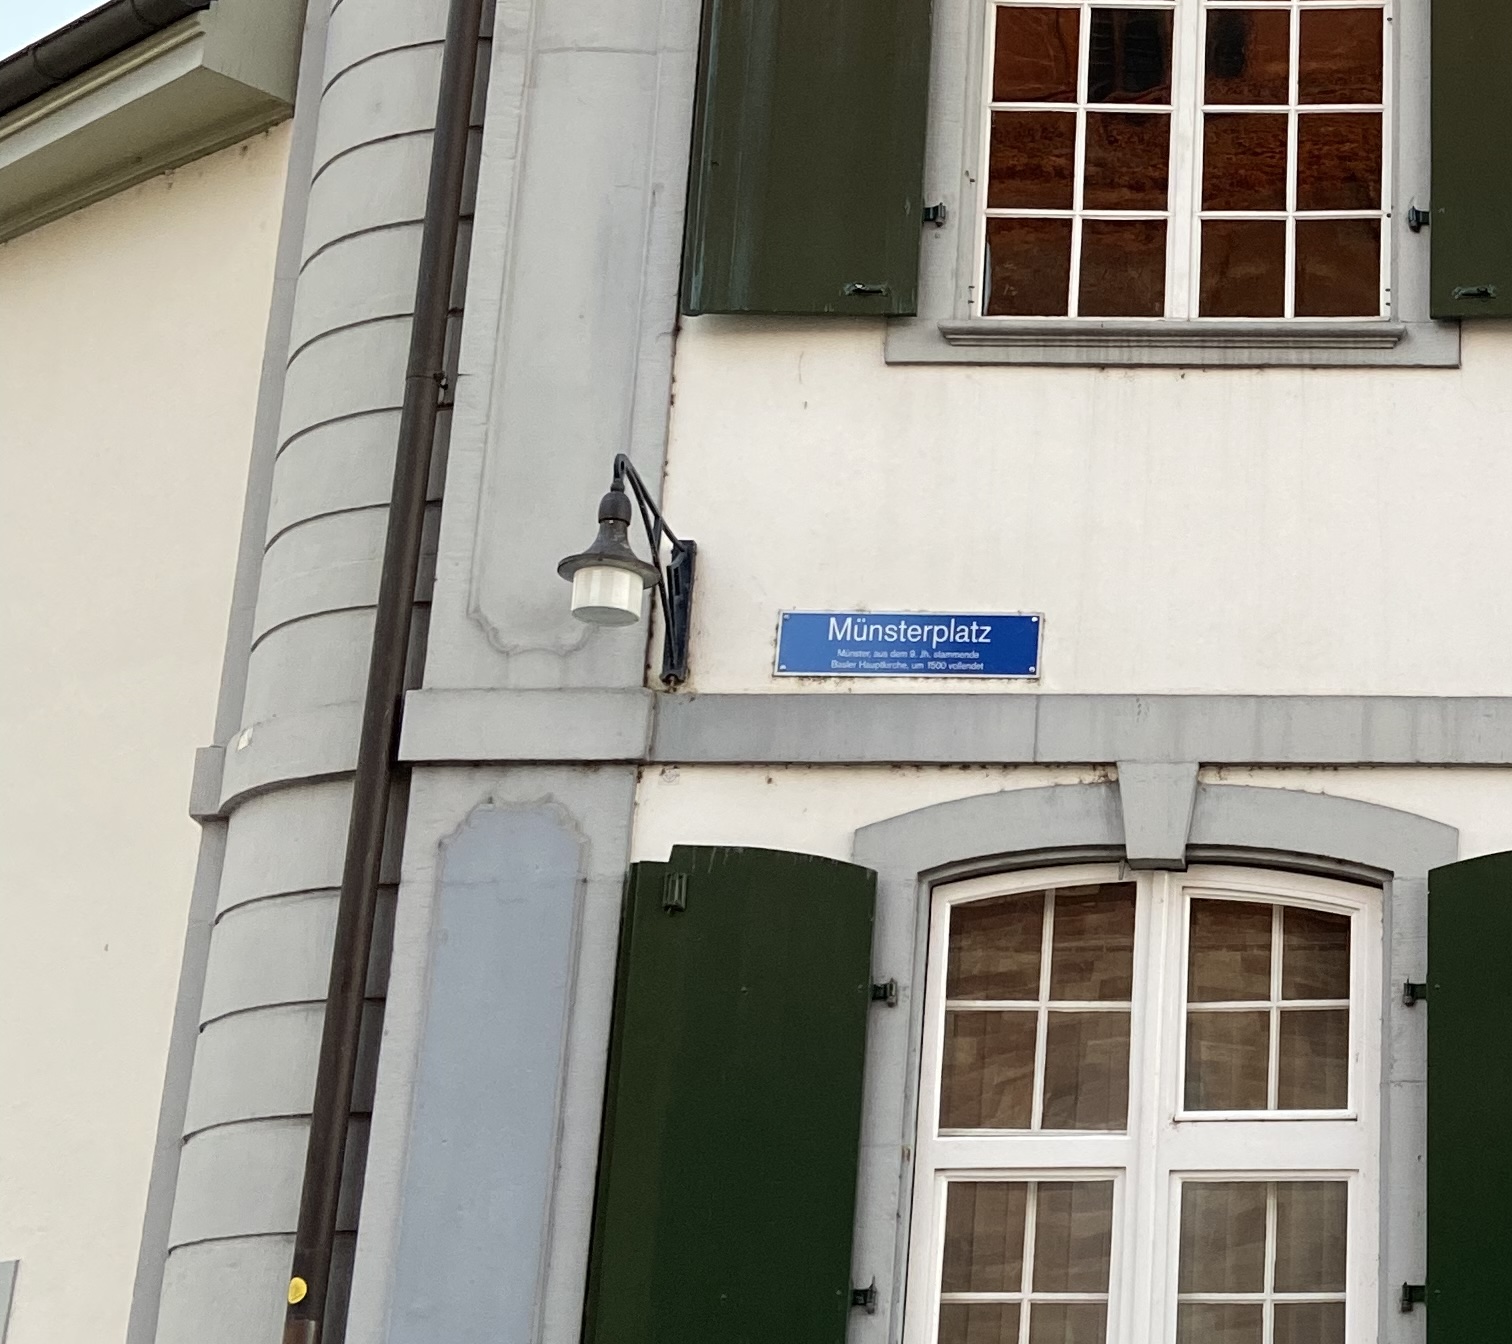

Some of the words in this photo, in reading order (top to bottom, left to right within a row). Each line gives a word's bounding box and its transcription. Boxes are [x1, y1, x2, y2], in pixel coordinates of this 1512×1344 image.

[828, 617, 992, 649] Münsterplatz
[837, 649, 871, 658] Münster,
[873, 650, 888, 658] aus
[890, 649, 908, 658] dem
[933, 649, 980, 659] stammende
[831, 660, 857, 669] Basler
[927, 661, 947, 670] 1500
[948, 661, 984, 670] vollendet
